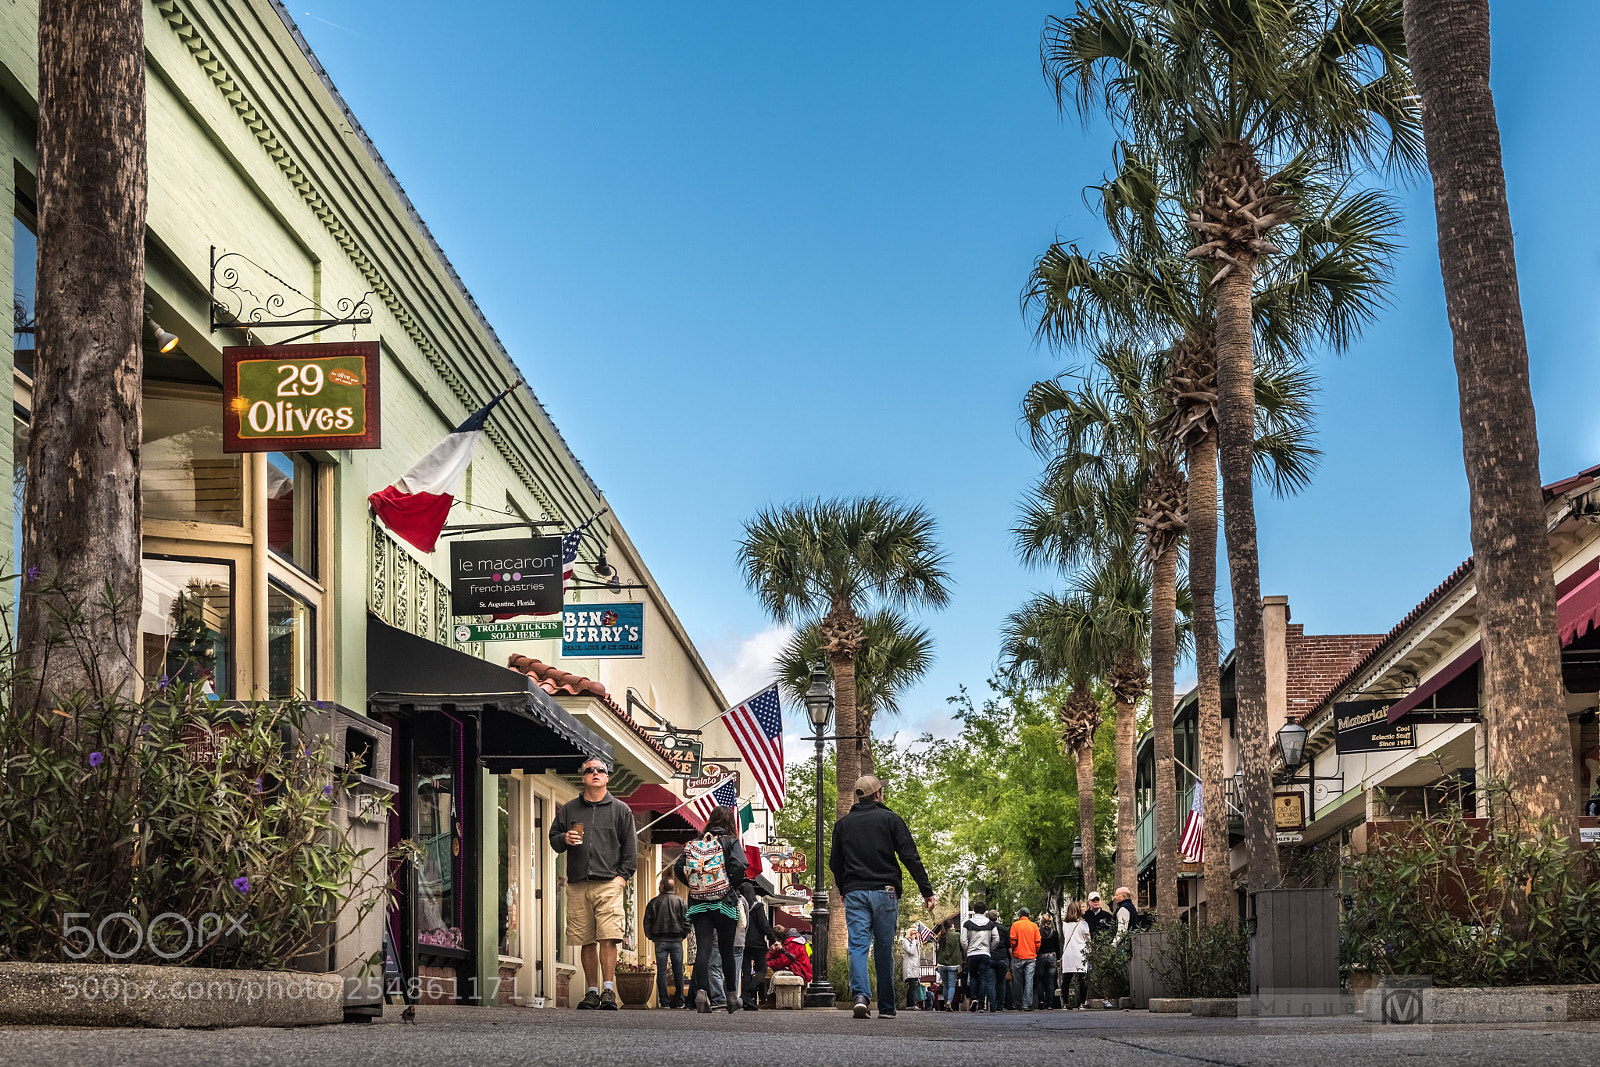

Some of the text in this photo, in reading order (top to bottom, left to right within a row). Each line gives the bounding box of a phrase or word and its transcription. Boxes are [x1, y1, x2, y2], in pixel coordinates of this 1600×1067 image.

[277, 363, 324, 397] 29
[248, 400, 354, 433] Olives
[459, 557, 554, 572] le macaron
[470, 583, 544, 595] french pastries
[517, 599, 536, 607] Florida
[564, 611, 602, 627] BEN
[476, 623, 518, 633] TROLLEY
[520, 622, 558, 631] TICKETS
[563, 624, 639, 643] JERRY'S
[491, 631, 541, 640] SOLD HERE
[687, 776, 717, 788] Gelato
